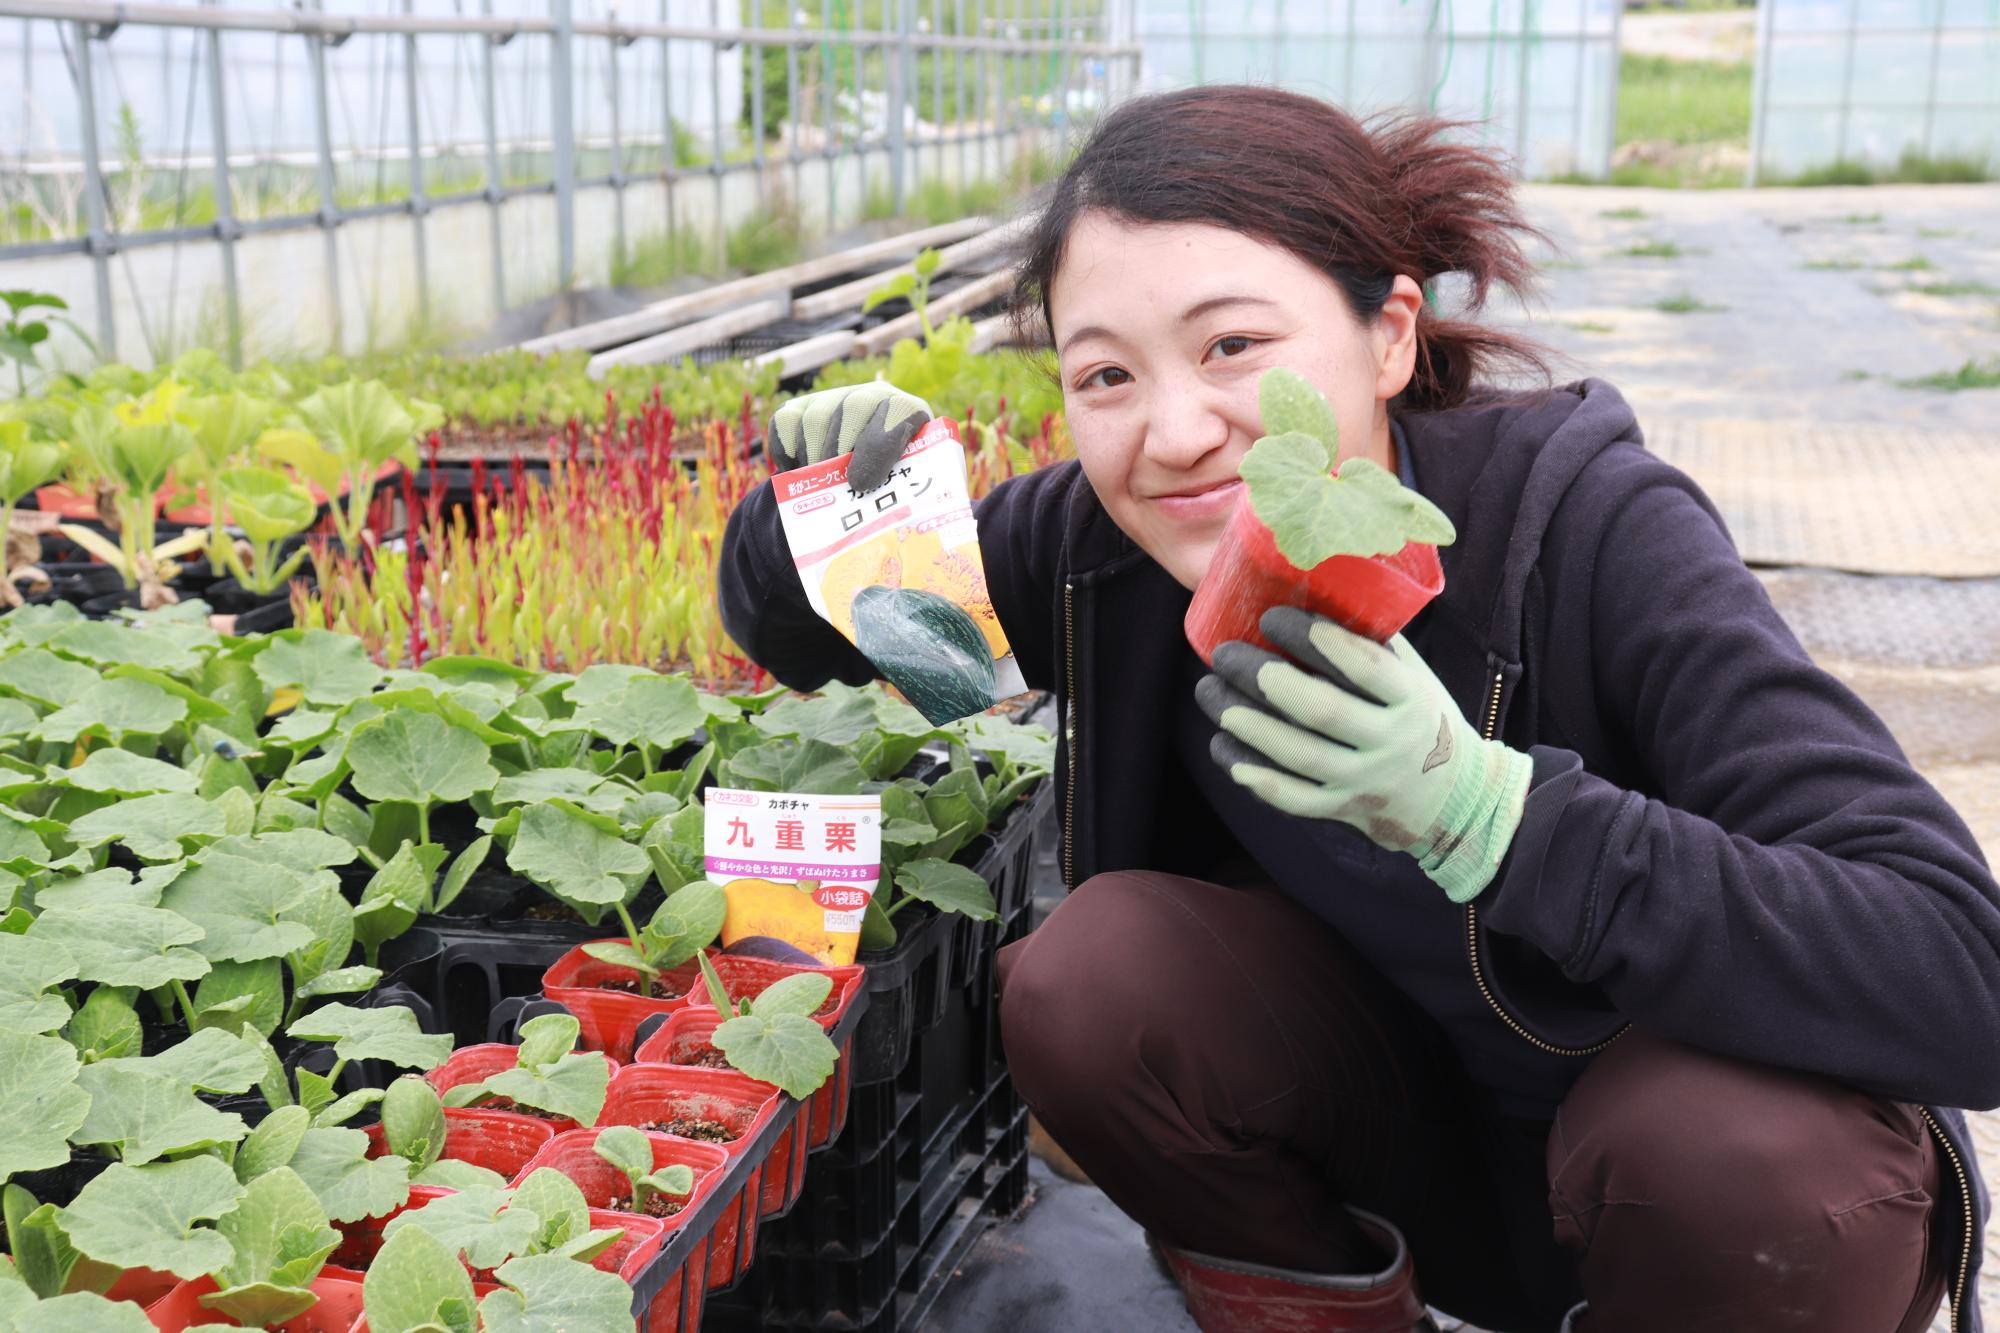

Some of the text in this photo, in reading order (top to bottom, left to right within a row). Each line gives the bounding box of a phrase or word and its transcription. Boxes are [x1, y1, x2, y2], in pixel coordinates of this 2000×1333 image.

[847, 466, 912, 501] カチャ
[841, 477, 933, 532] ロロン
[768, 799, 809, 811] カボチャ
[726, 816, 857, 853] 九重栗
[796, 866, 868, 878] ずばぬけたうまさ
[820, 891, 864, 906] 小袋詰
